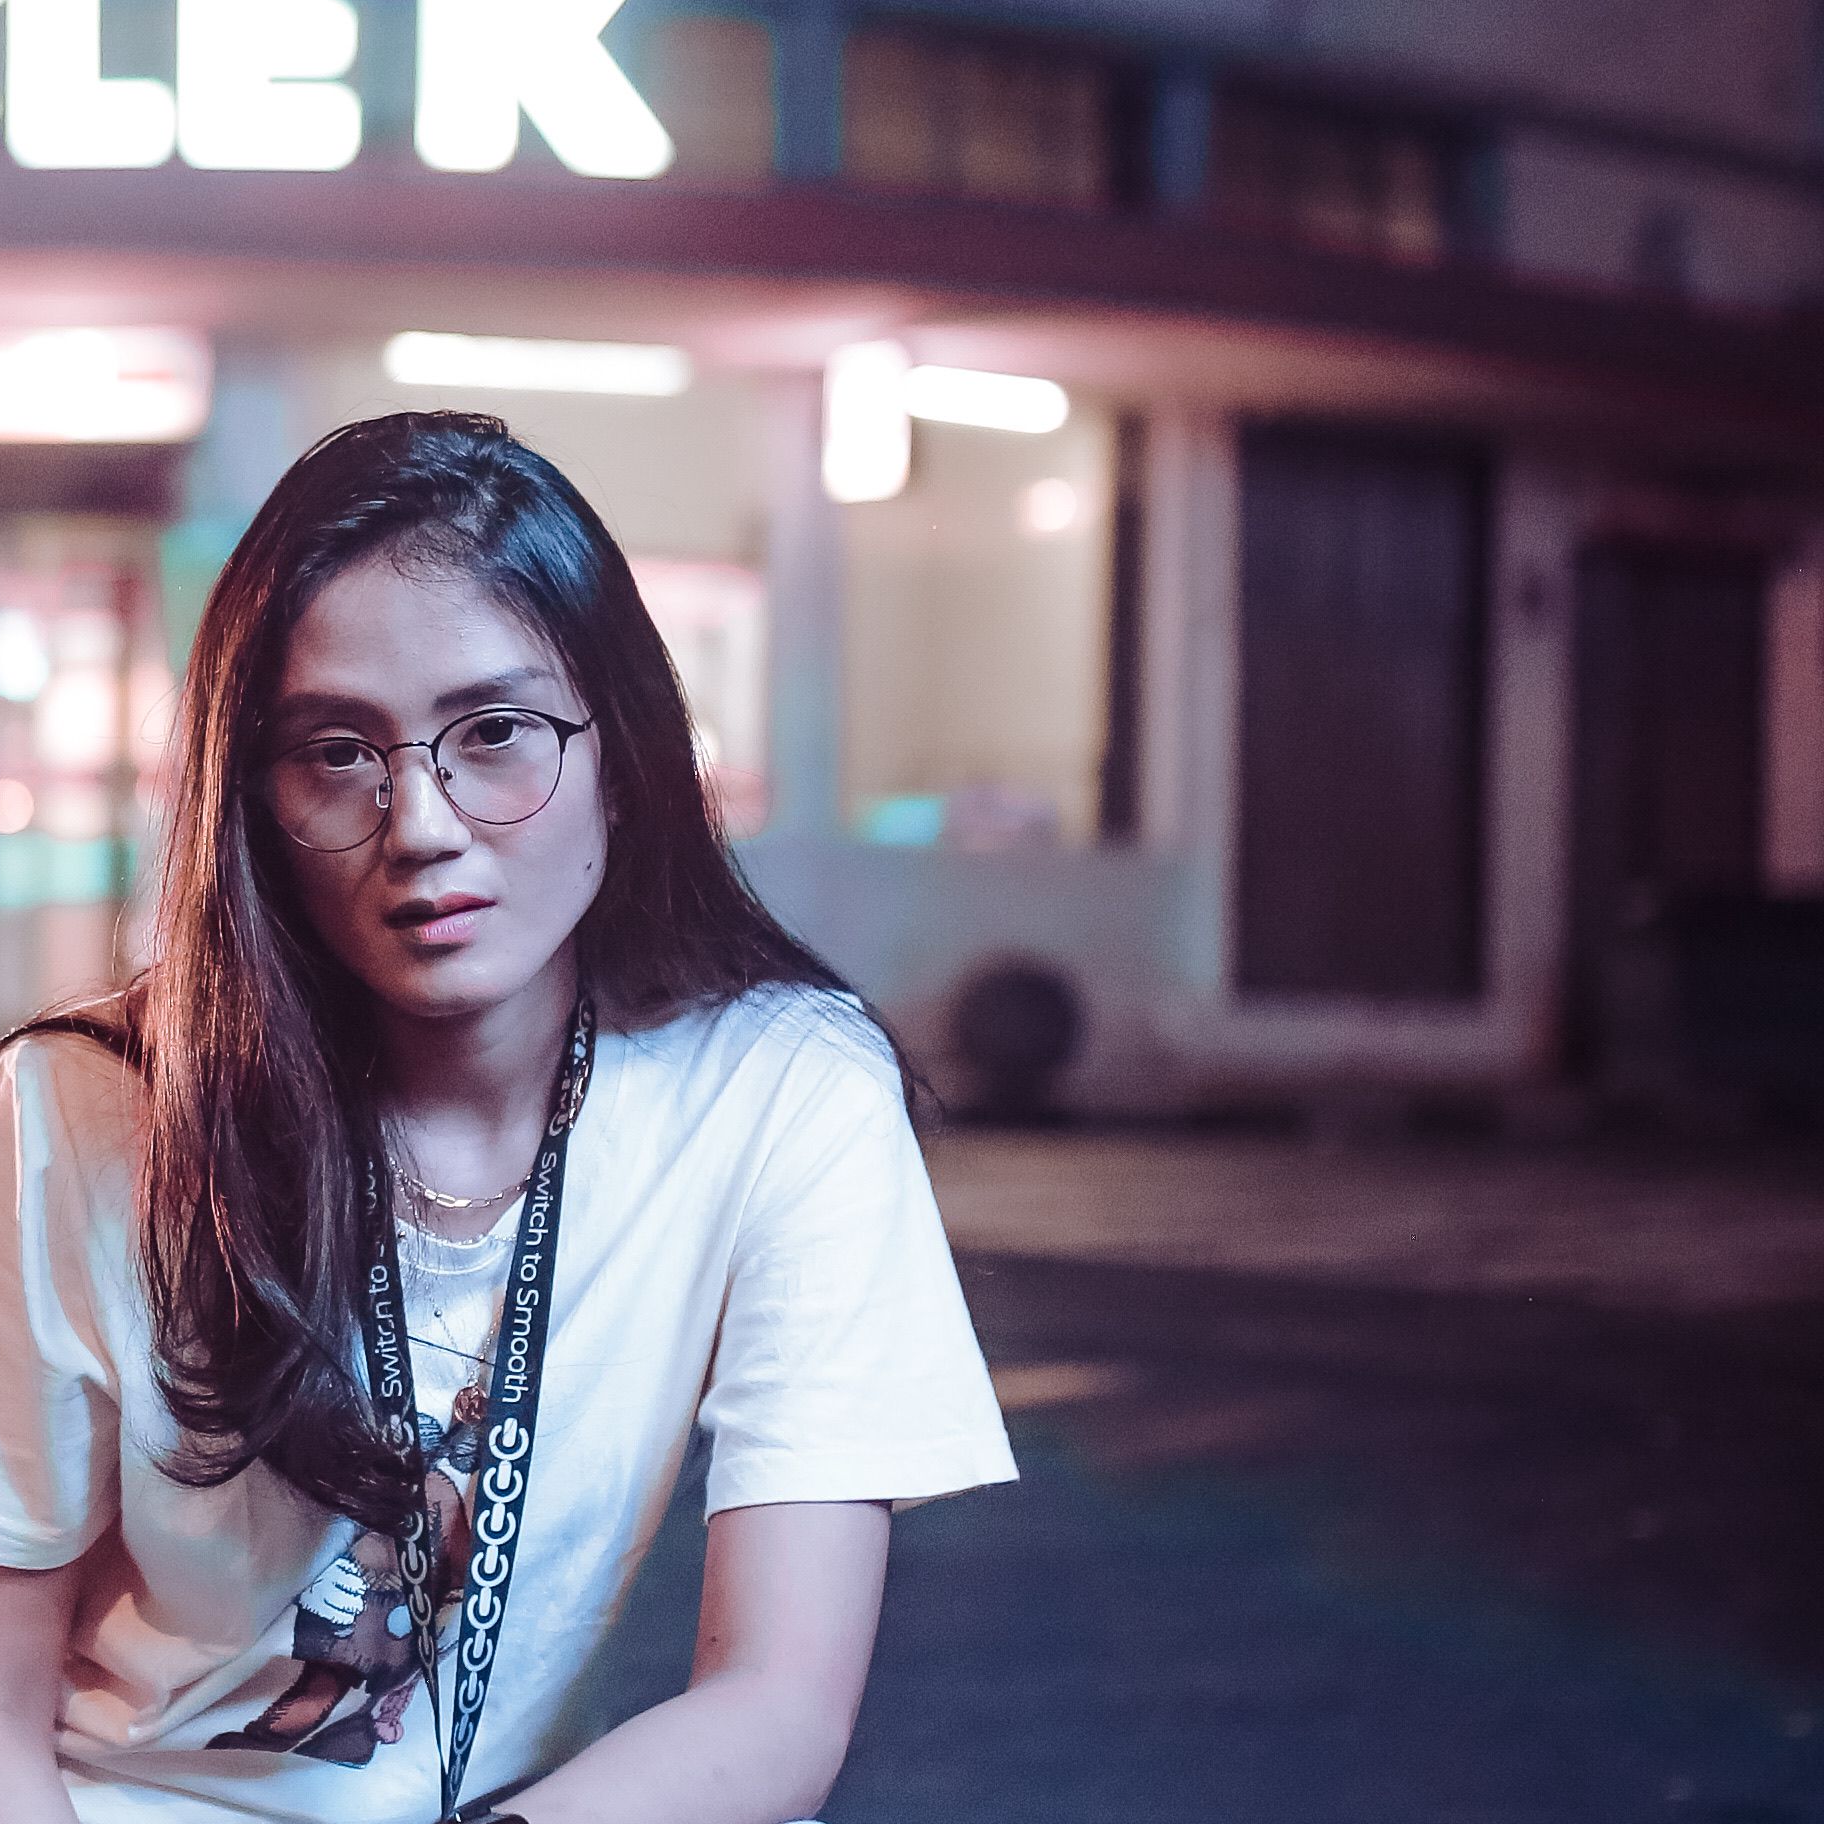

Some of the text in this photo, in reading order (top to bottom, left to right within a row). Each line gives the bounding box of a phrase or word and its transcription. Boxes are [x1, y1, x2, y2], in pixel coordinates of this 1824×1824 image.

[368, 1265, 390, 1295] to
[503, 1151, 557, 1405] Switch to Smooth
